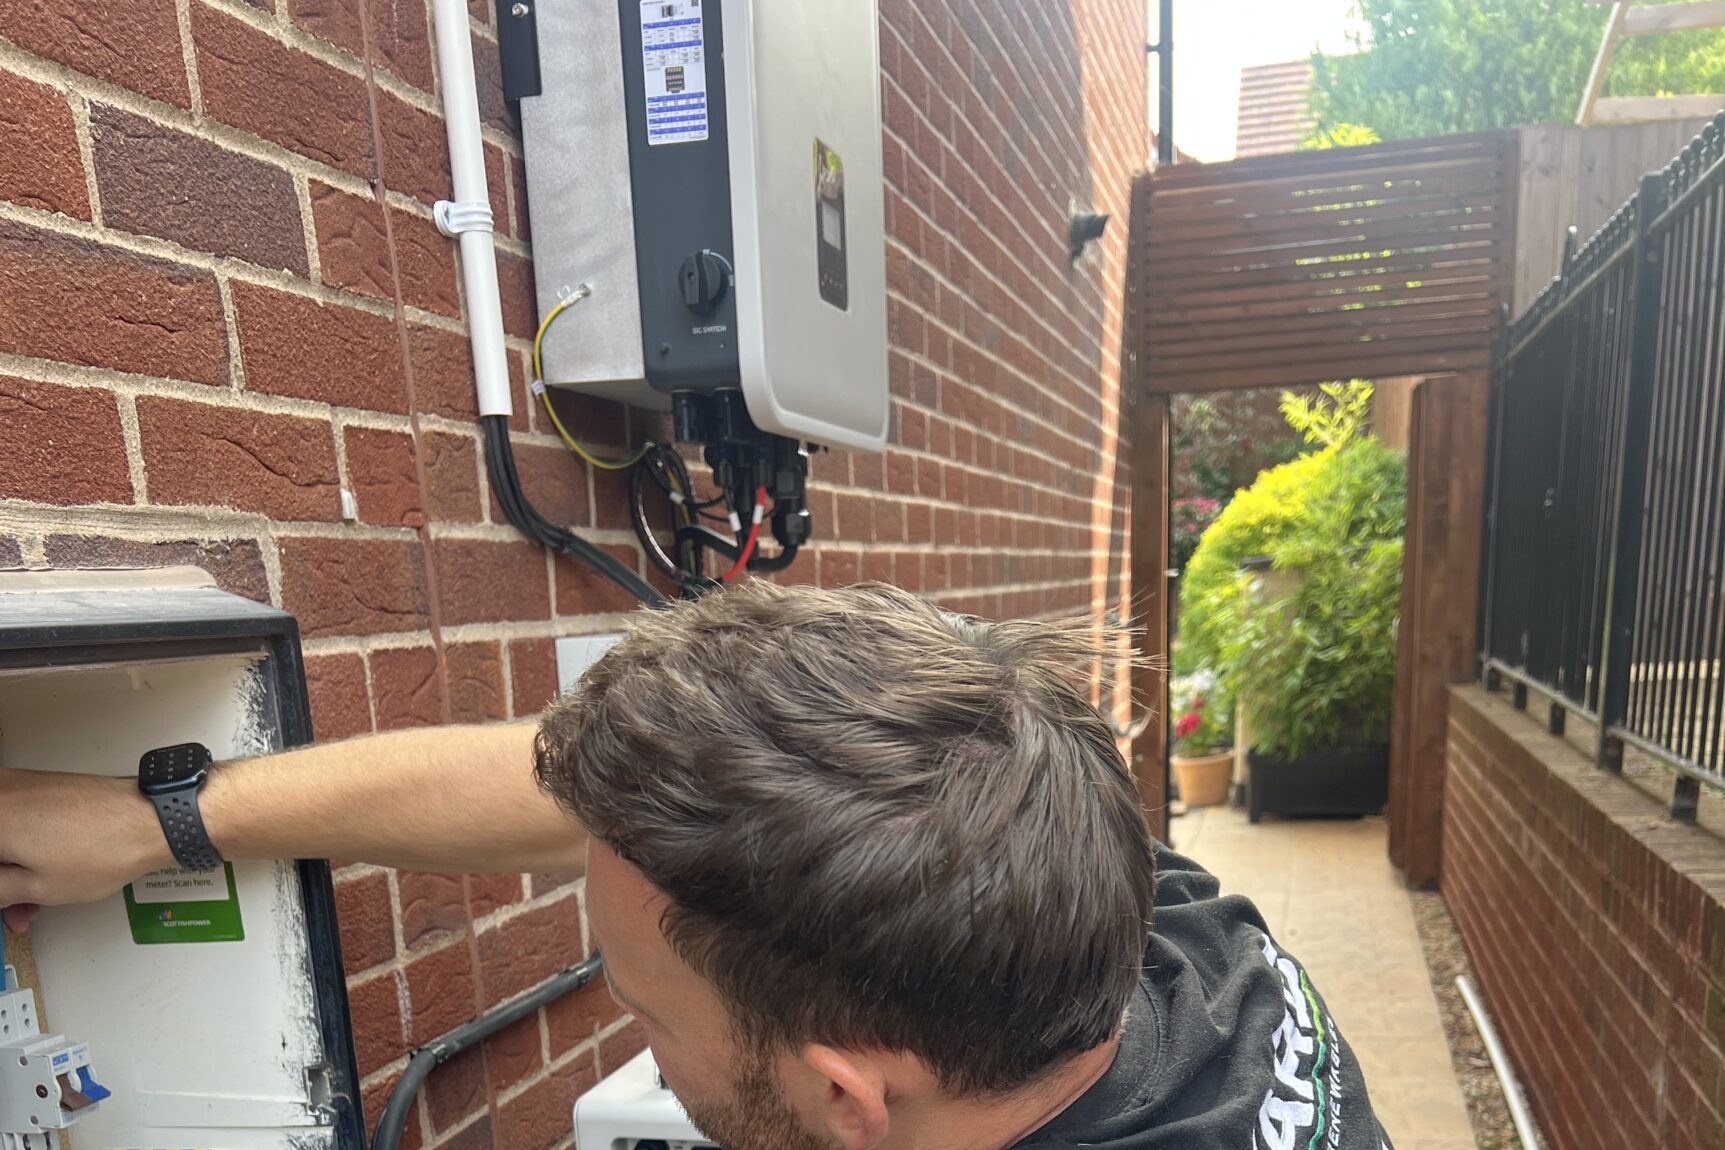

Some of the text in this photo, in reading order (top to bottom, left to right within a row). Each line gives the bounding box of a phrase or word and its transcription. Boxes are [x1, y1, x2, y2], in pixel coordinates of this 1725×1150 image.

[160, 866, 178, 876] help
[145, 878, 214, 888] meter? Scan here.
